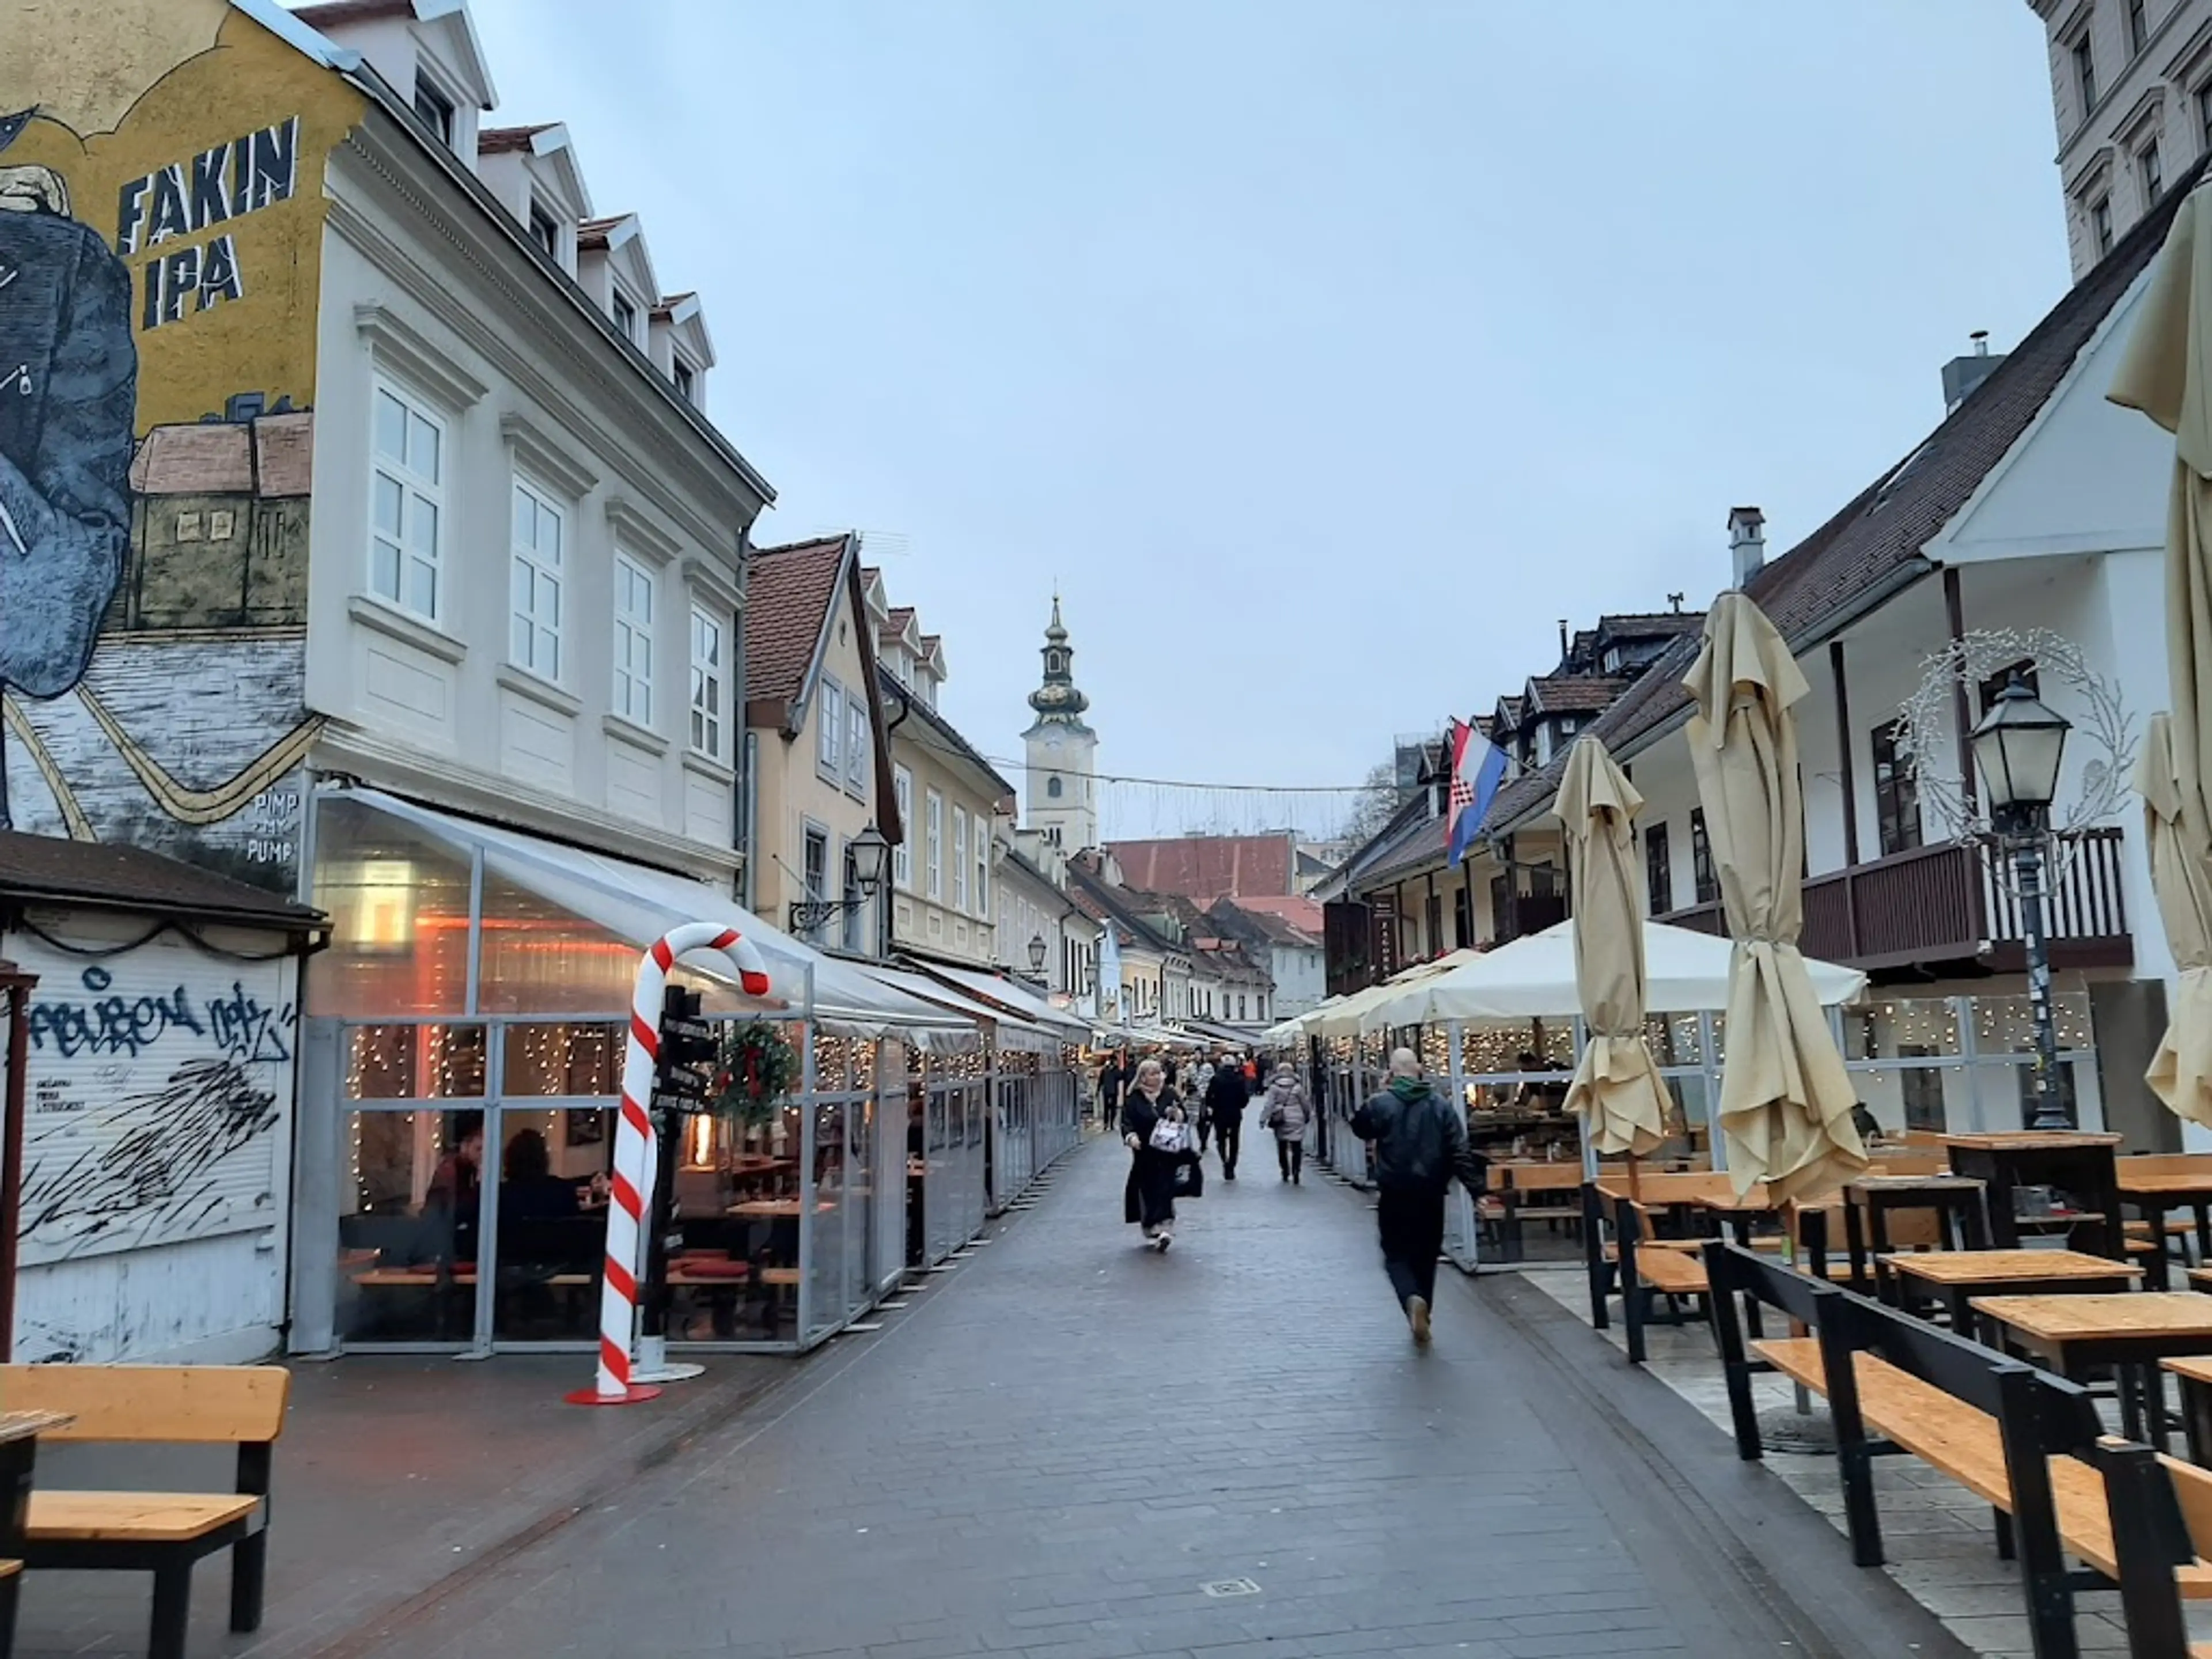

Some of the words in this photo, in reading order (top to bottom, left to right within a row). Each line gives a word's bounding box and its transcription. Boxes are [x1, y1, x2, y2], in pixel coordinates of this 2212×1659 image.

[117, 115, 300, 256] FAKIN
[143, 234, 244, 331] IPA
[255, 794, 299, 817] PIMP
